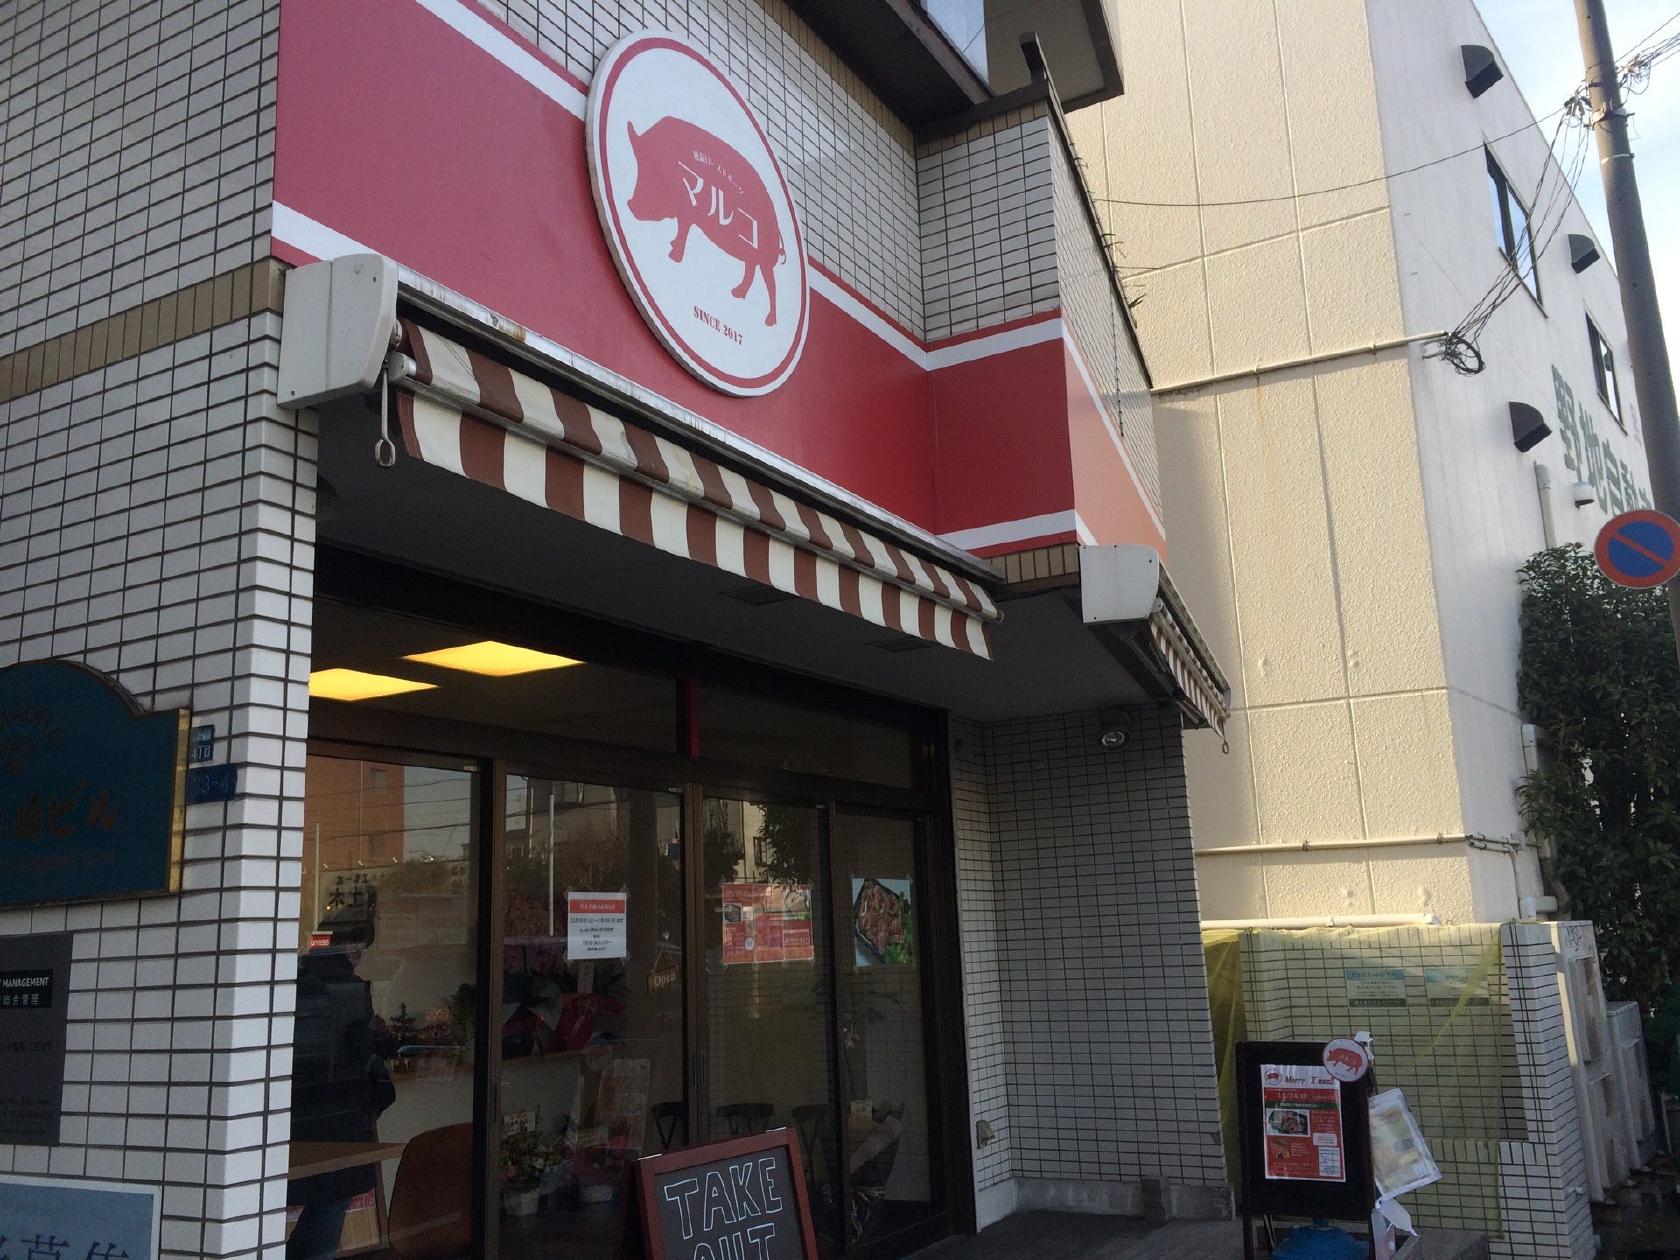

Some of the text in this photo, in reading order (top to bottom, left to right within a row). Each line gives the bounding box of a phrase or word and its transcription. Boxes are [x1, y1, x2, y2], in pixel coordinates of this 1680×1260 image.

[678, 160, 759, 250] マルコ
[693, 305, 743, 346] SINCE 2017
[2, 976, 50, 988] MANAGEMENT
[663, 1157, 783, 1240] TAKE
